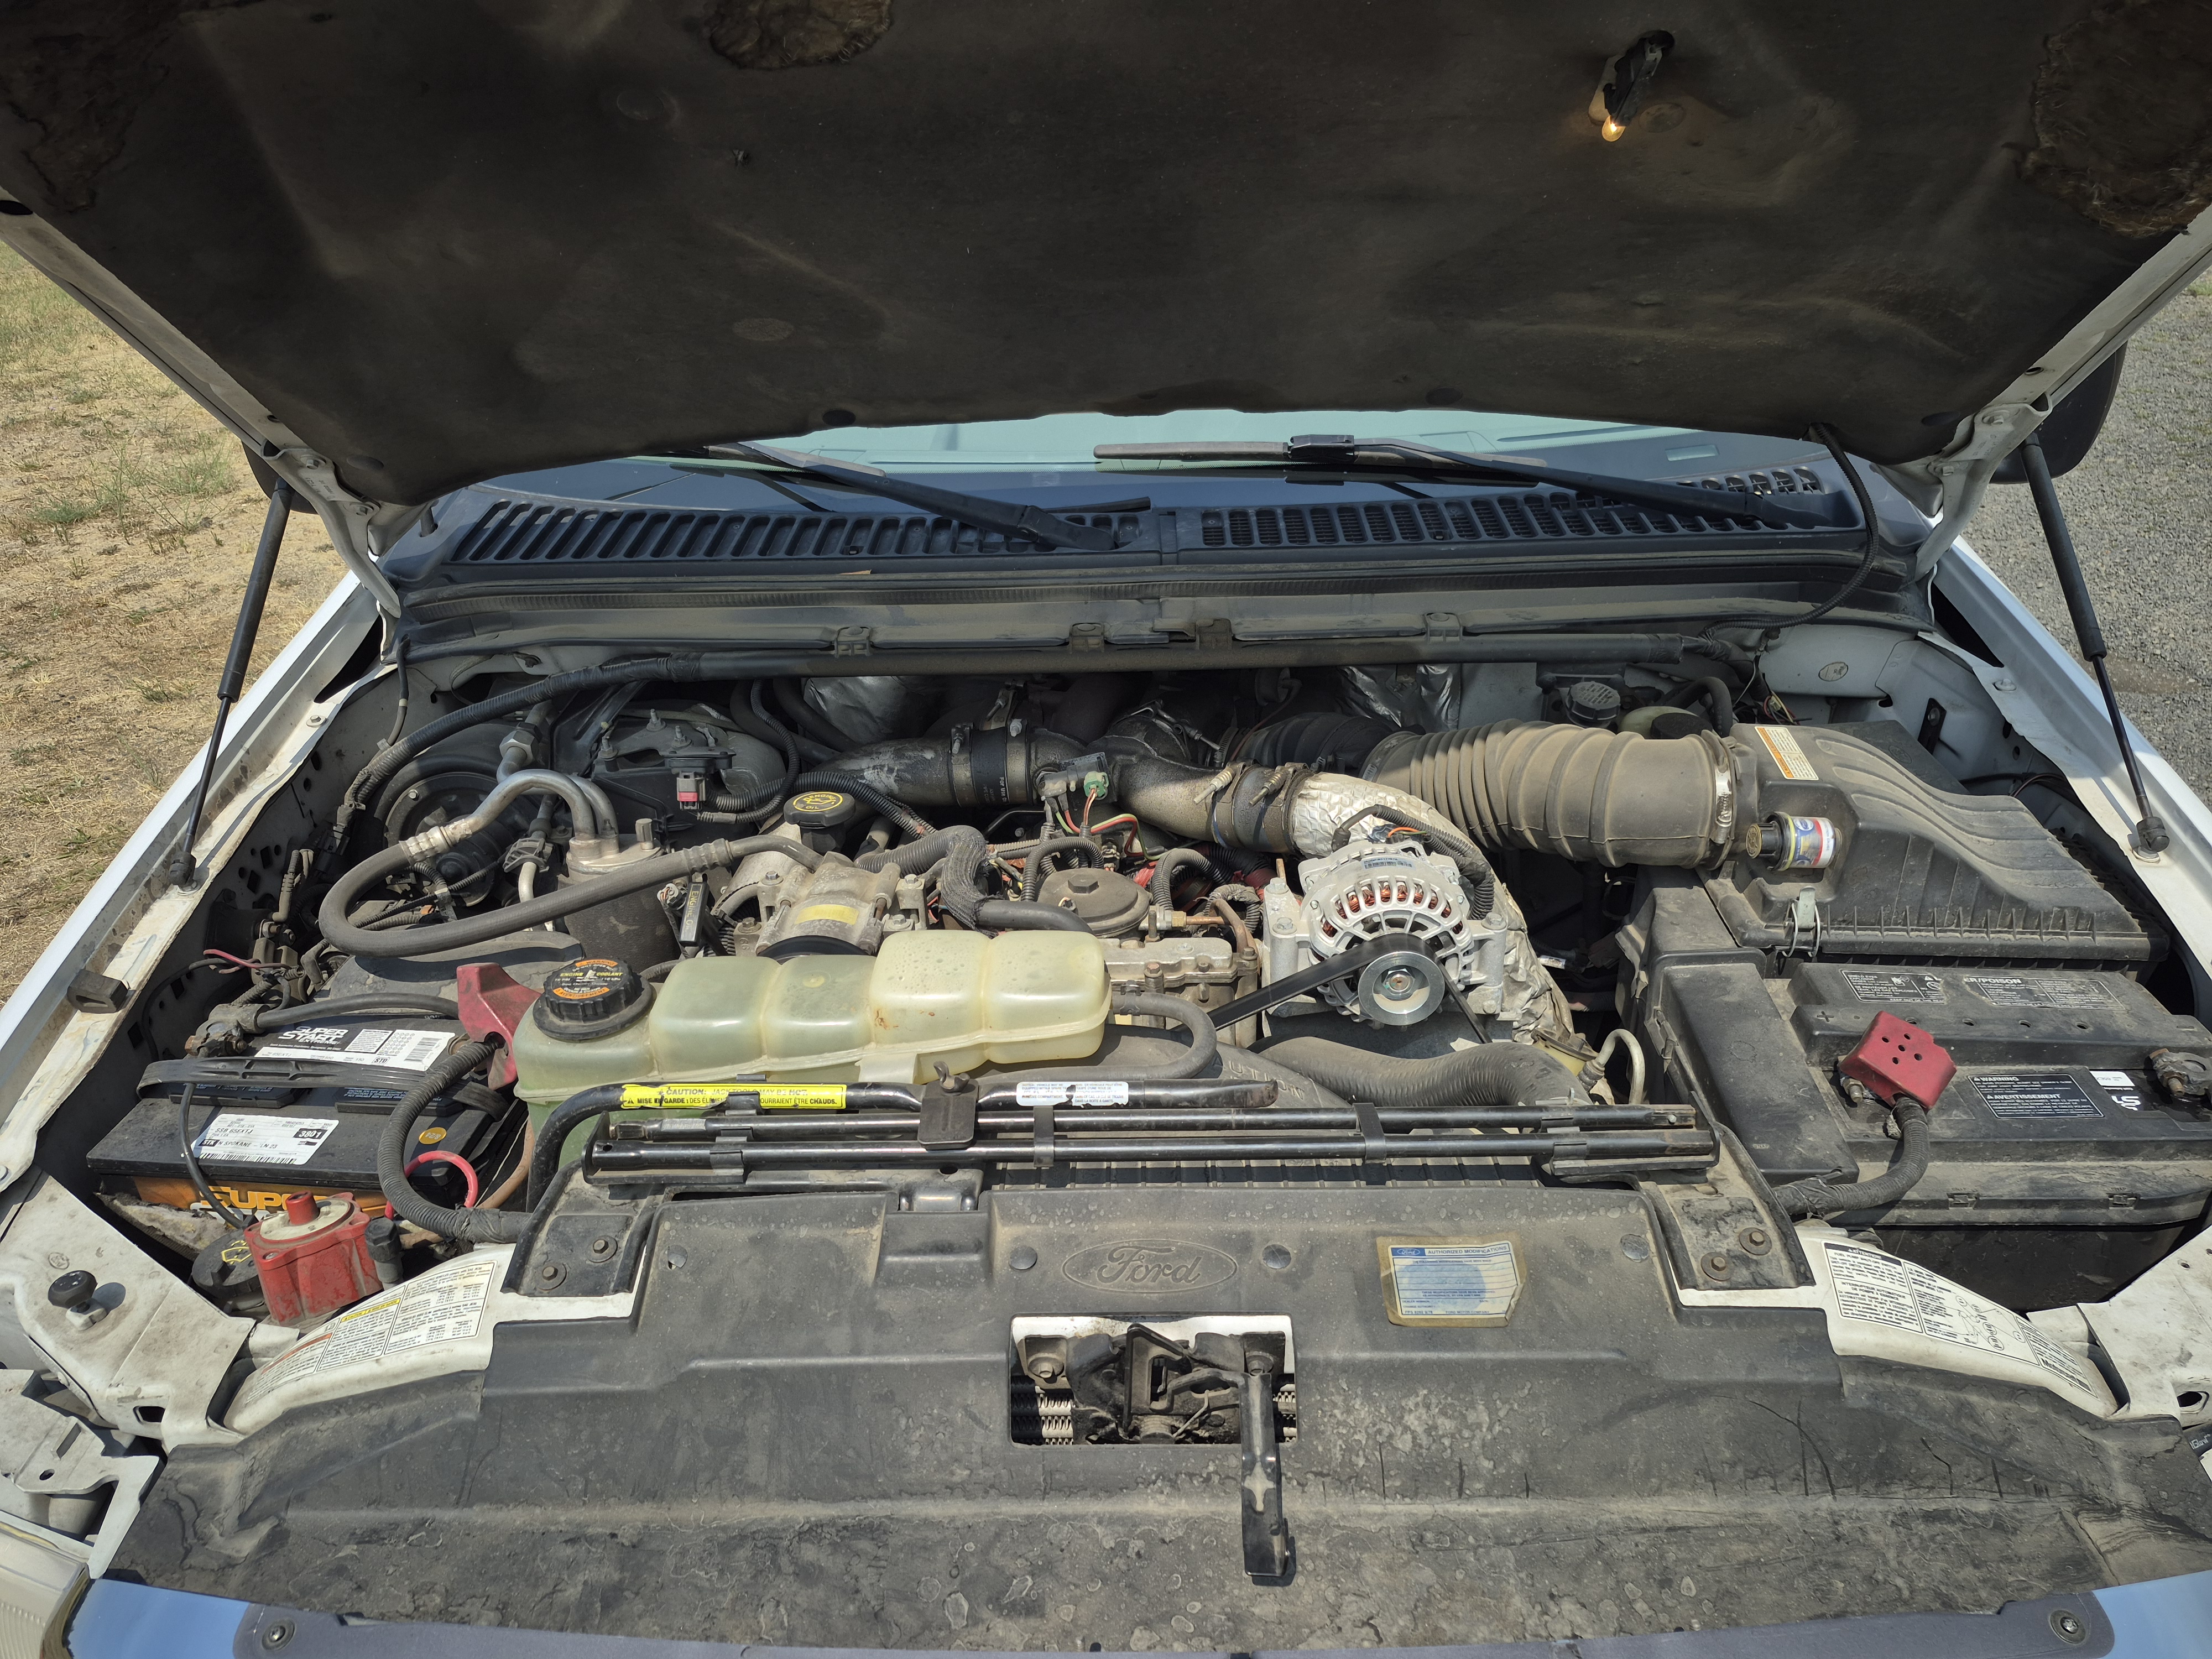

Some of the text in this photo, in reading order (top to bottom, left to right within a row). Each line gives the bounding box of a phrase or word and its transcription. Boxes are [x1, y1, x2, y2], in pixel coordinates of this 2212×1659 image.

[687, 891, 700, 918] ENGINE
[278, 1031, 345, 1041] START
[291, 1026, 349, 1036] SUPER
[299, 1130, 322, 1139] 3801
[1464, 1245, 1507, 1254] MODIFICATIONS
[1096, 1245, 1202, 1284] Ford
